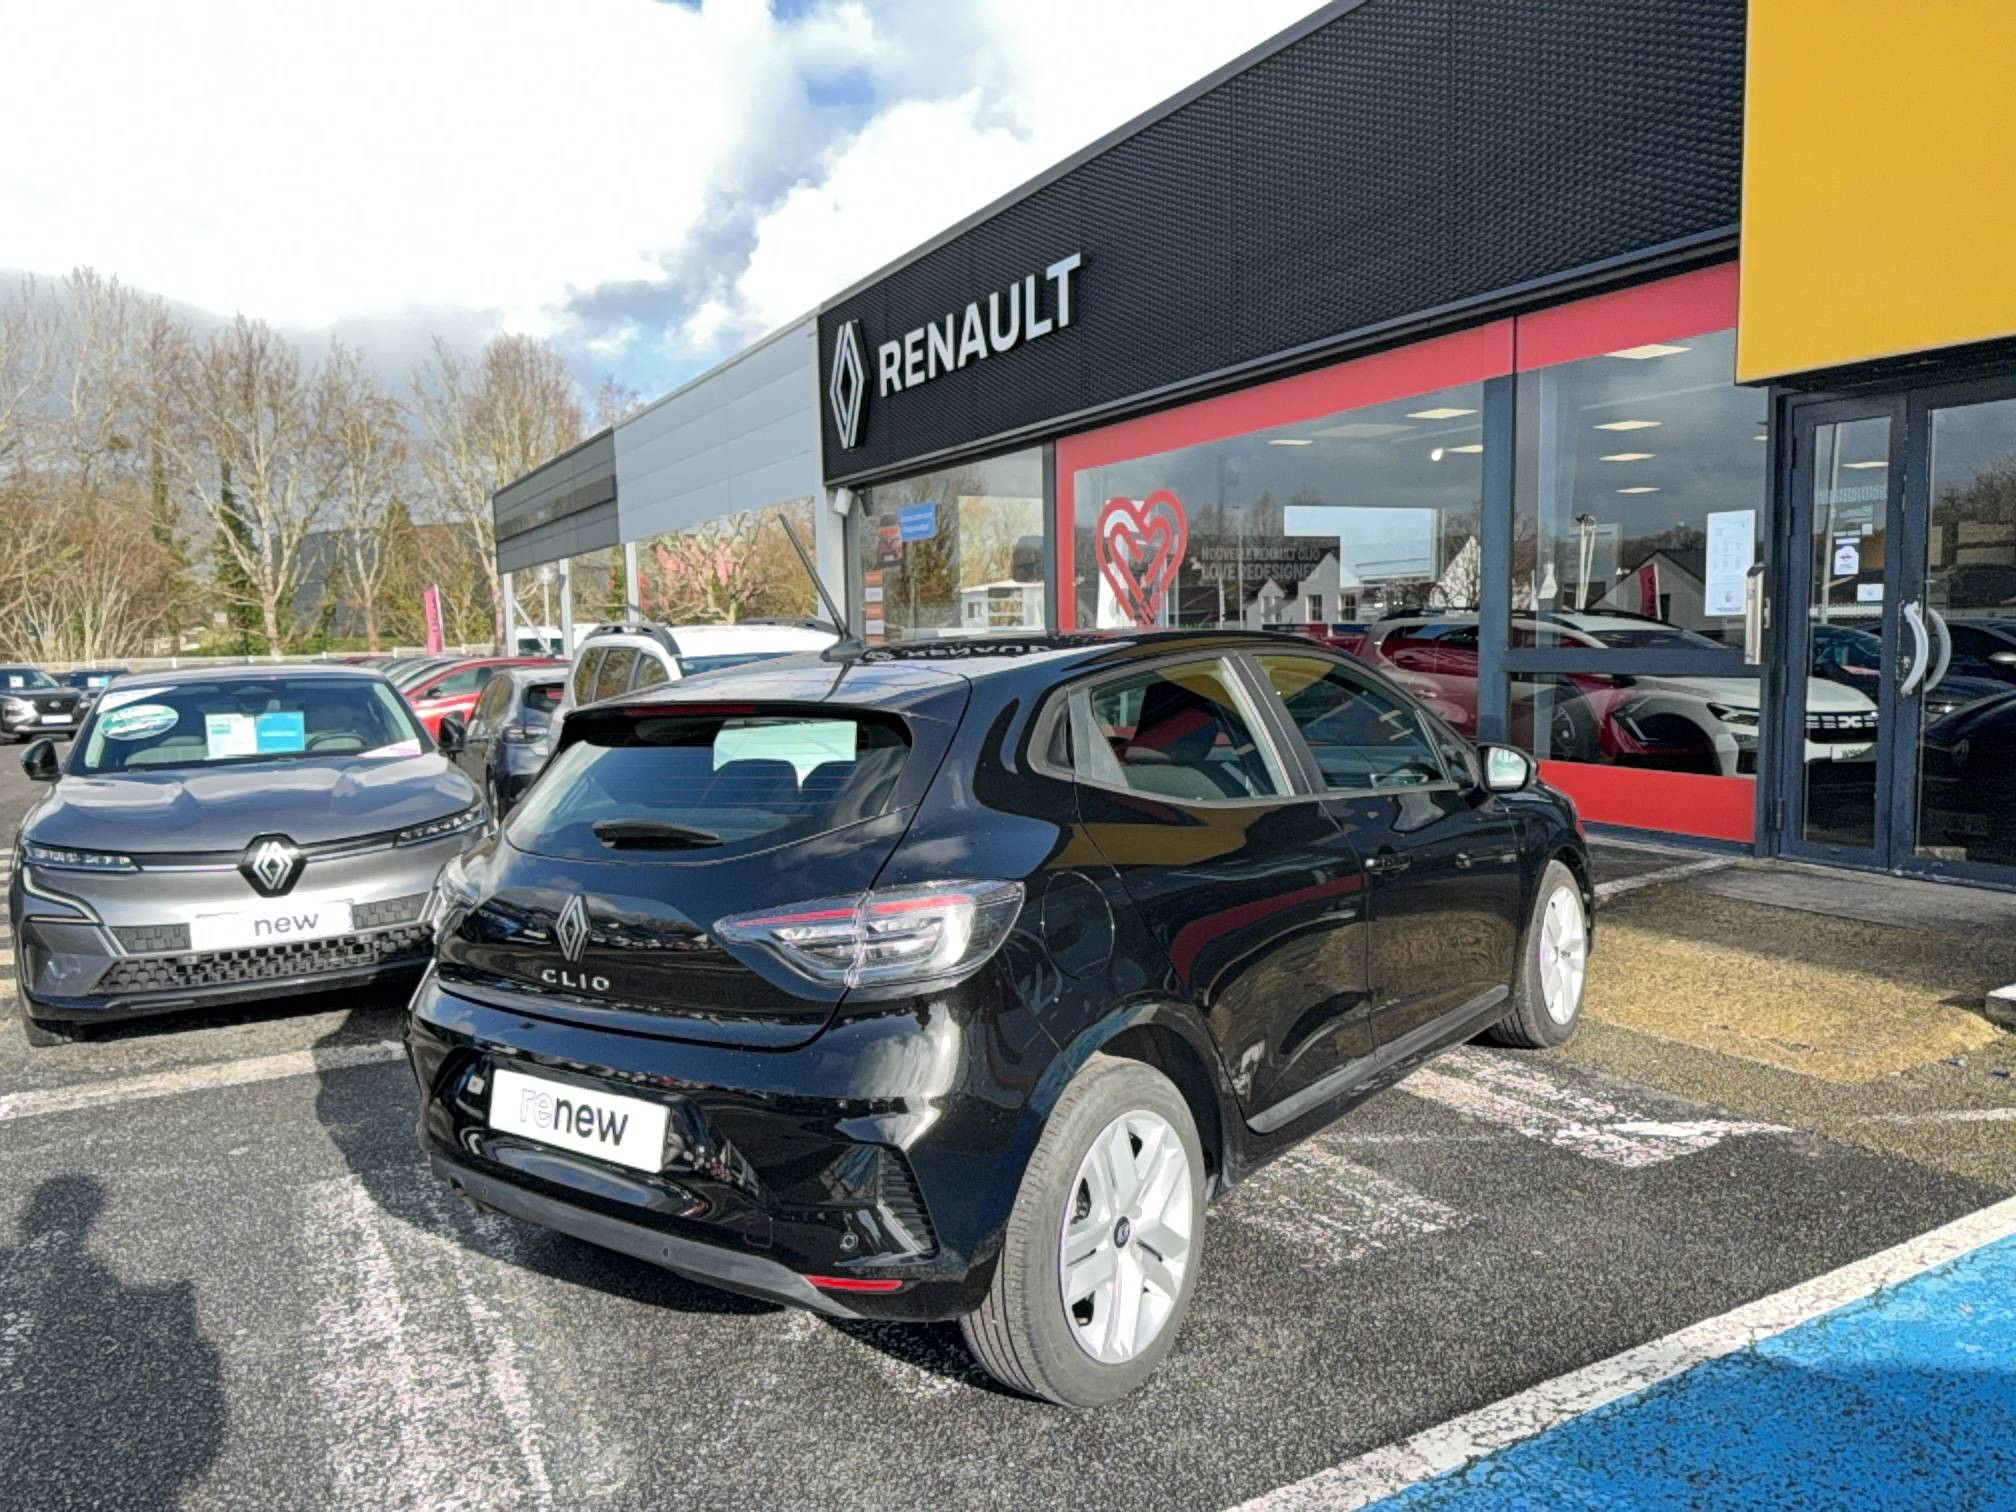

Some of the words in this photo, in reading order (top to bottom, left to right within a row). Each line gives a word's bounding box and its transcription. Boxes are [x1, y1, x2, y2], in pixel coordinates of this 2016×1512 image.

[878, 252, 1082, 397] RENAULT
[1201, 563, 1236, 581] LOVE
[541, 969, 610, 991] CLIO
[520, 1088, 629, 1146] renew
